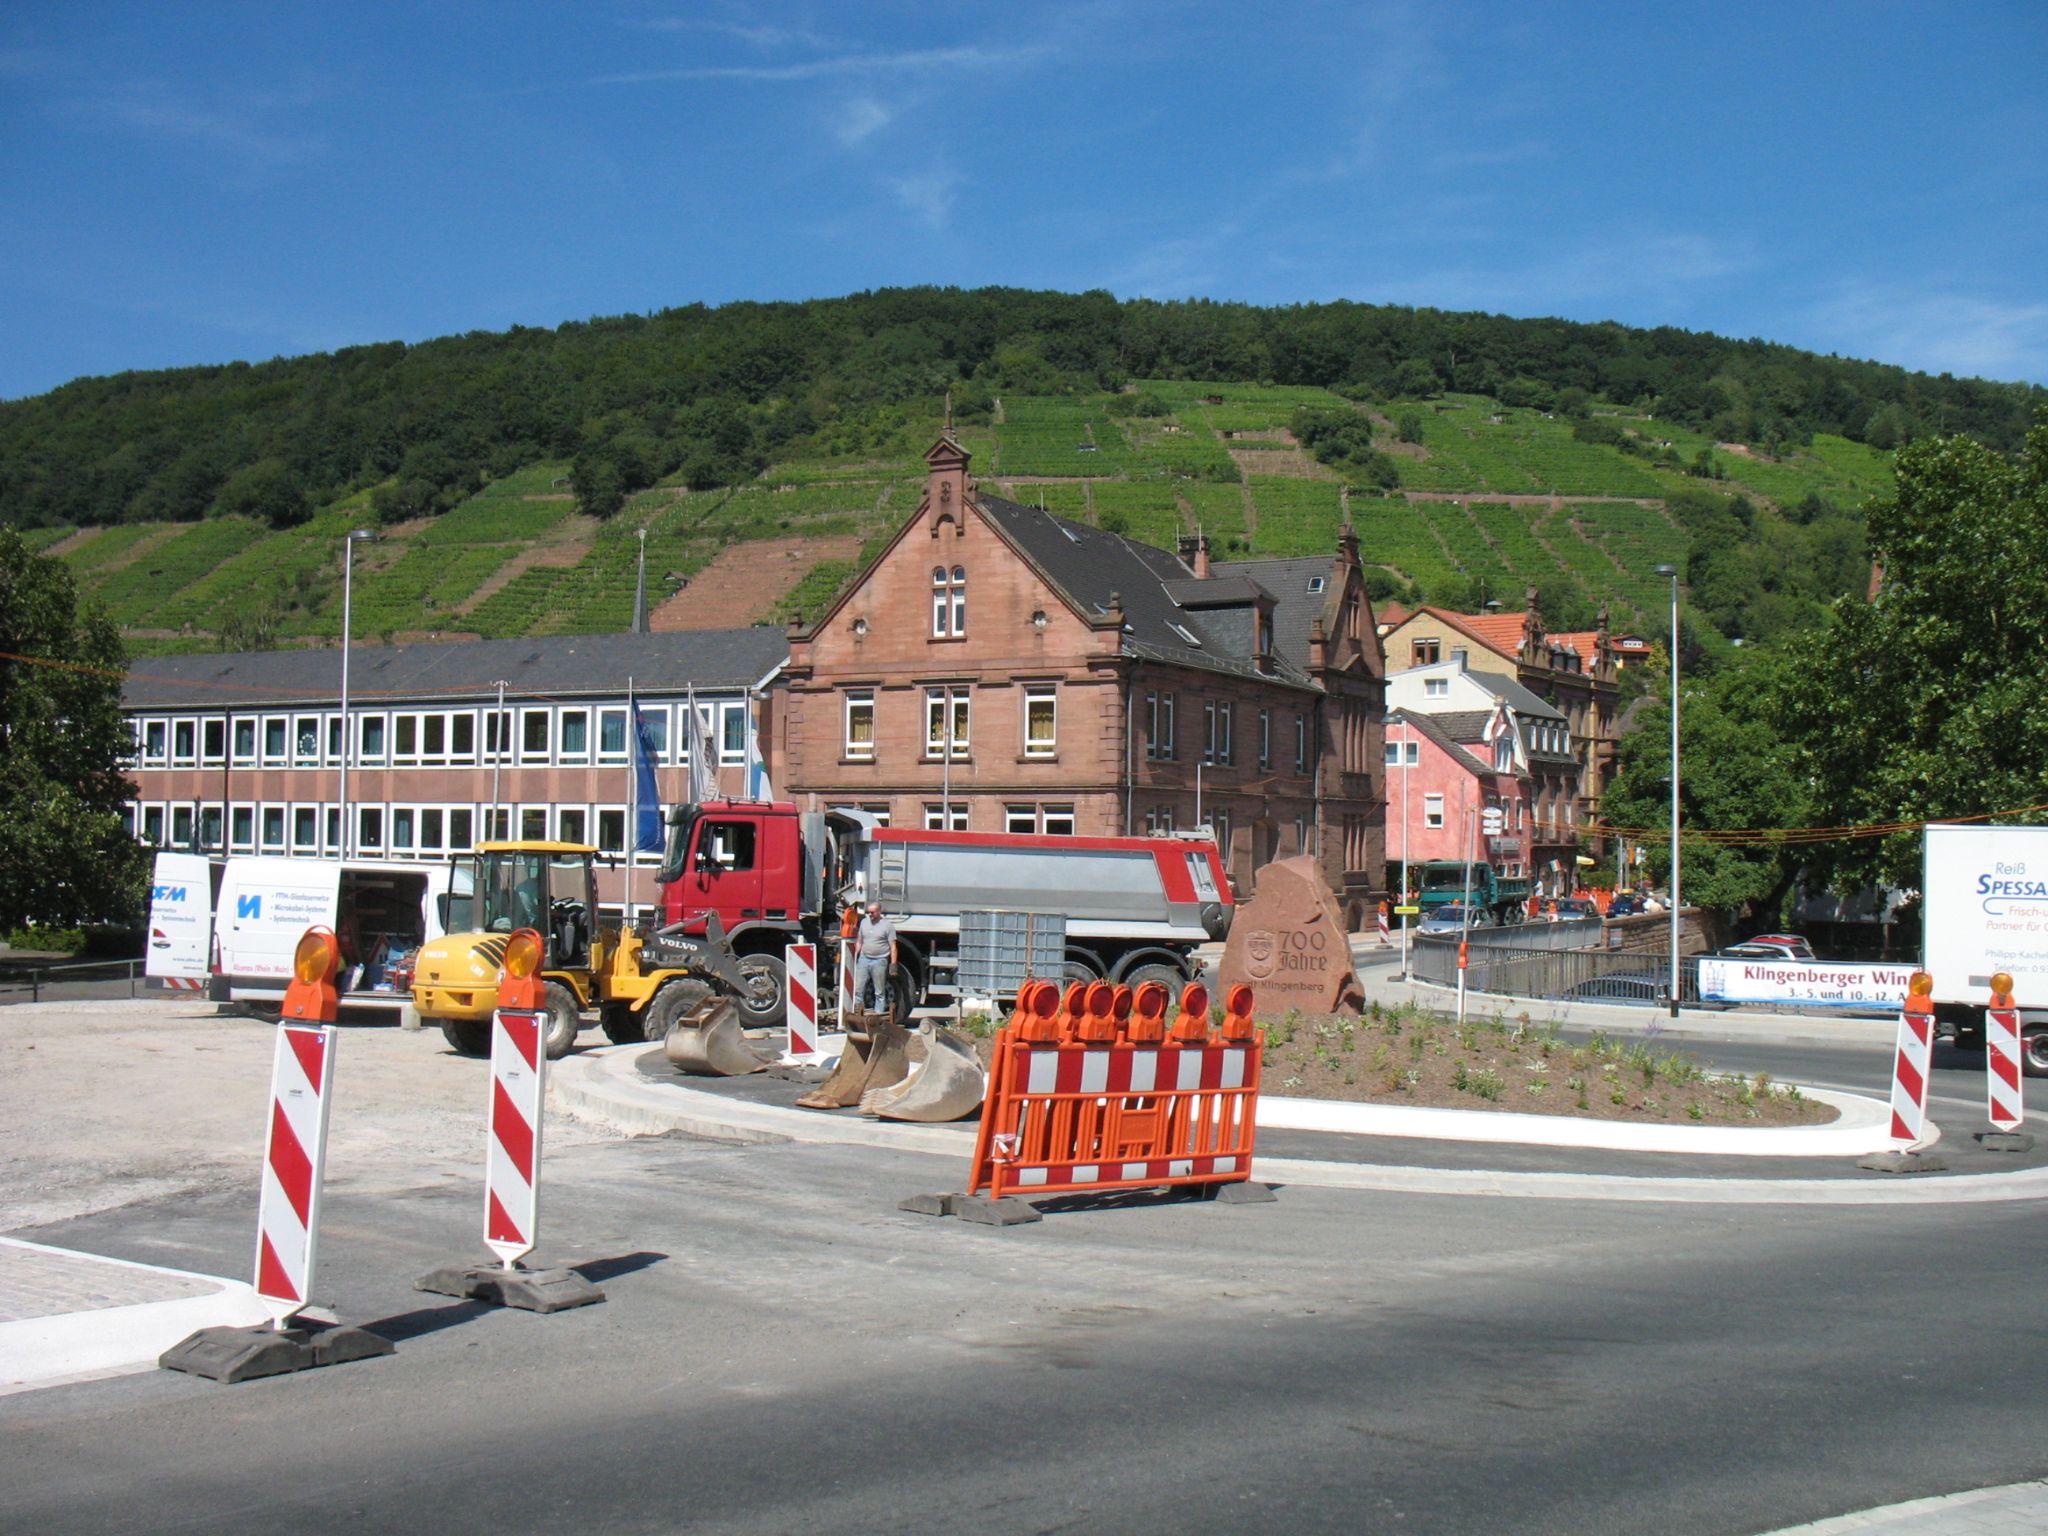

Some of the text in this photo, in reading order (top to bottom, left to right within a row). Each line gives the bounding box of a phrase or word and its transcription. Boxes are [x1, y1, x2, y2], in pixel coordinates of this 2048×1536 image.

[1996, 862, 2026, 875] Reiß
[1976, 873, 2048, 896] SPESSA
[1986, 920, 2024, 931] Partner
[659, 937, 698, 952] VOLVO
[1279, 930, 1326, 951] 700
[1277, 951, 1328, 972] Jahre
[1744, 965, 1907, 988] Klingenberger Win
[1261, 980, 1325, 993] Klingenberg
[1820, 989, 1844, 1000] und
